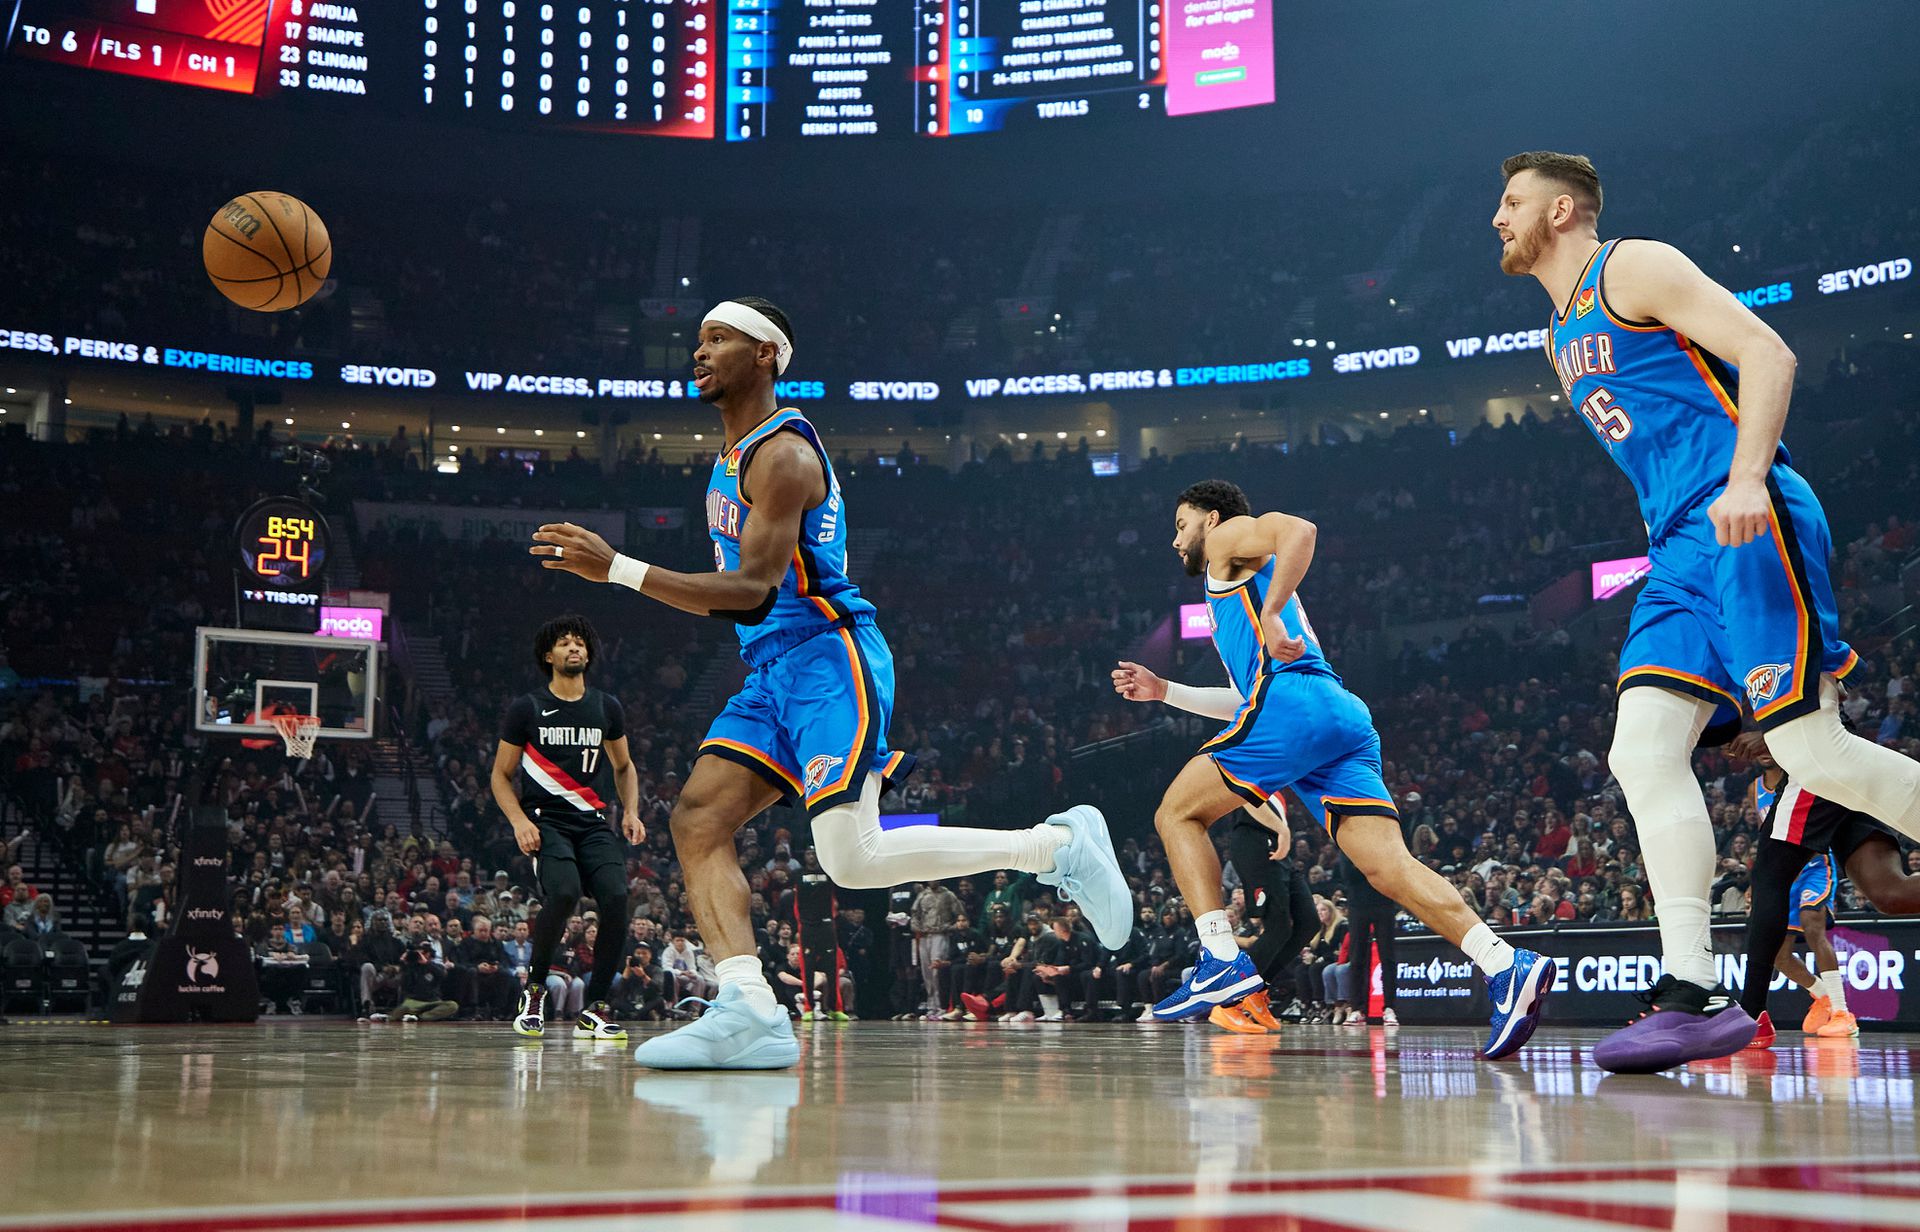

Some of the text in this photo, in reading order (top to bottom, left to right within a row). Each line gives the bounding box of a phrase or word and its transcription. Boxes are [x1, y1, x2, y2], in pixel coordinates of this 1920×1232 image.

[735, 12, 945, 30] 2-2 3-POINTERS 1-3
[958, 6, 969, 19] 0
[1185, 15, 1206, 27] for
[1223, 8, 1255, 23] ages
[309, 2, 358, 23] AVDIJA
[425, 16, 438, 34] 0
[467, 21, 476, 39] 1
[505, 25, 514, 42] 1
[541, 28, 554, 45] 0
[579, 31, 592, 49] 0
[616, 33, 629, 51] 0
[652, 35, 665, 53] 0
[686, 37, 707, 55] -8
[958, 23, 969, 36] 0
[284, 21, 707, 78] 17 SHARPE 0 0 0 0 1 0 0 -8
[798, 35, 837, 48] POINTS
[928, 31, 939, 45] 0
[23, 25, 236, 78] TO 6 FLS 1 CH 1
[788, 53, 816, 66] FAST
[853, 51, 891, 64] POINTS
[928, 49, 939, 62] 0
[1002, 52, 1041, 67] POINTS
[279, 45, 706, 100] 23 CLINGAN 3 1 0 0 0 0 0 -8
[741, 71, 752, 84] 2
[957, 75, 968, 89] 0
[1092, 60, 1134, 76] FORCED
[279, 68, 706, 124] 33 CAMARA 1 1 0 0 0 2 1 -8
[741, 84, 937, 101] 2 ASSISTS 1
[742, 103, 937, 120] 1 TOTAL FOULS 1
[965, 93, 1150, 123] 10 TOTALS 2
[801, 122, 838, 135] BENCH
[838, 121, 878, 134] POINTS
[927, 120, 938, 134] 0
[1817, 257, 1913, 295] BEYOND
[0, 328, 314, 380] CESS, PERKS & EXPERIENCES
[1446, 336, 1482, 358] VIP
[1333, 344, 1420, 373] BEYOND
[340, 364, 437, 388] BEYOND
[465, 371, 502, 390] VIP
[505, 373, 594, 398] ACCESS,
[599, 379, 665, 398] PERKS
[668, 381, 684, 398] &
[965, 358, 1311, 398] VIP ACCESS, PERKS & EXPERIENCES
[849, 381, 940, 401] BEYOND
[268, 516, 315, 541] 8:54
[257, 537, 310, 578] 24
[264, 590, 319, 606] TISSOT
[321, 616, 374, 633] moda
[538, 726, 603, 747] PORTLAND
[580, 748, 600, 774] 17
[193, 856, 223, 867] xfinity
[187, 907, 225, 921] xfinity
[1396, 960, 1474, 980] First Tech
[178, 984, 226, 993] luckin coffee
[1395, 987, 1472, 998] federal credit union
